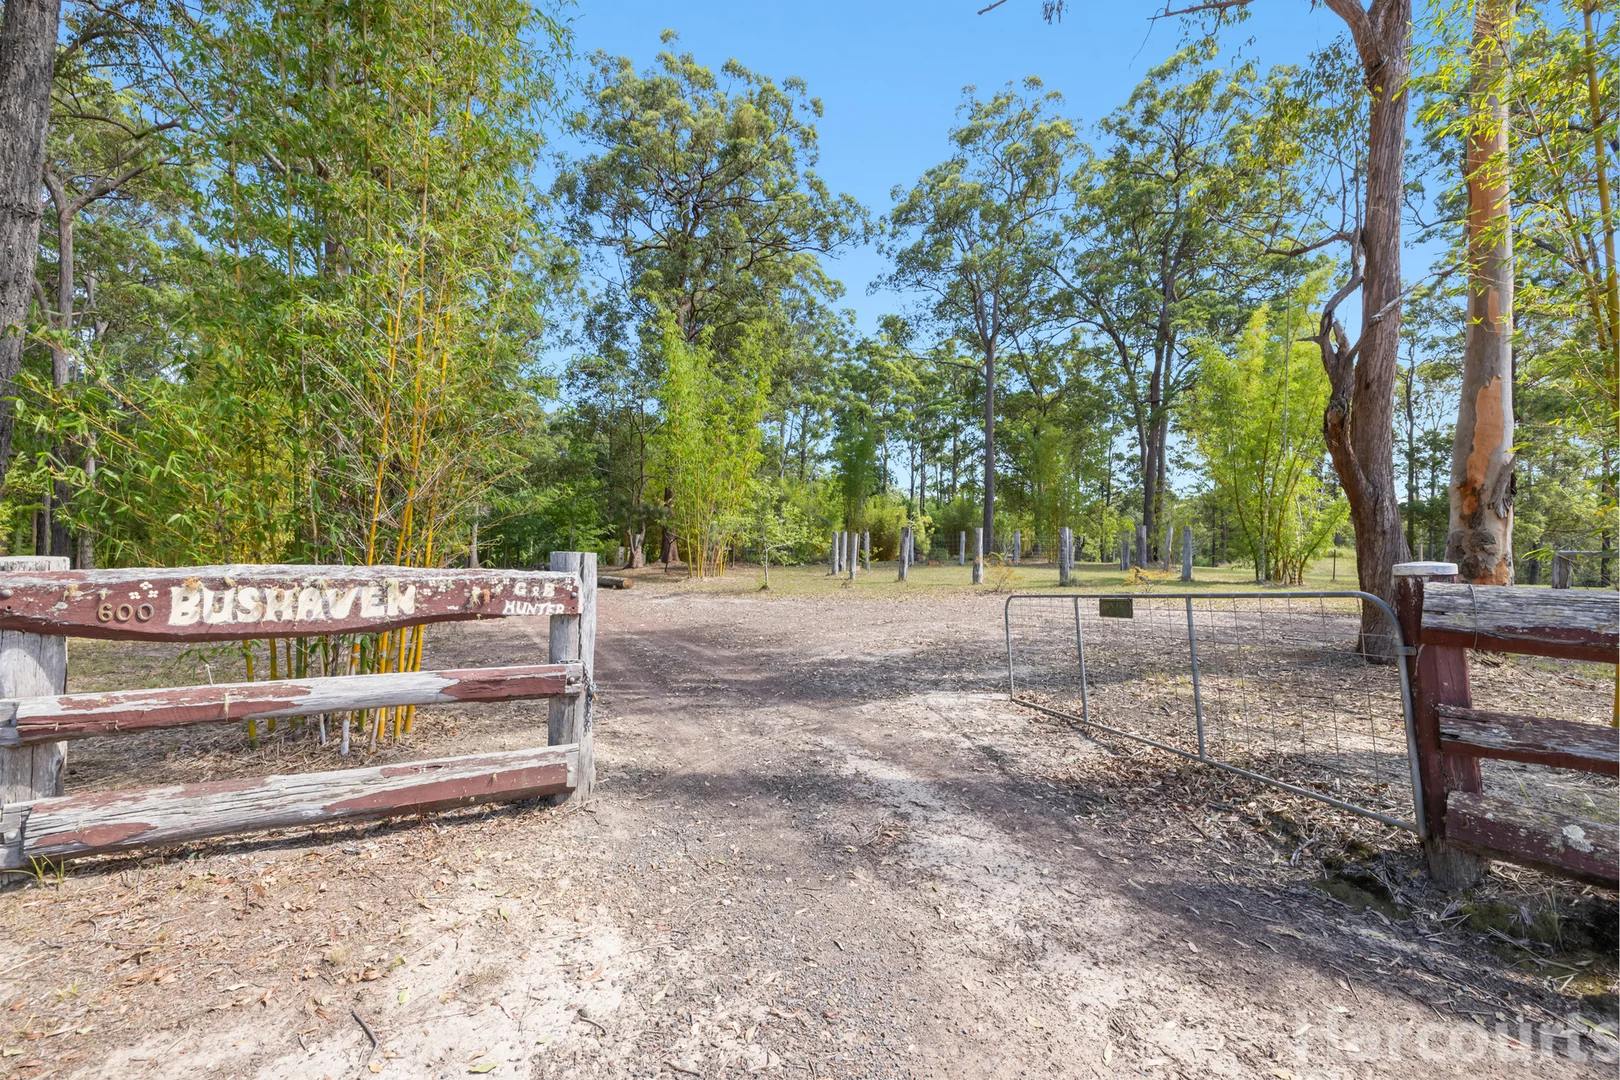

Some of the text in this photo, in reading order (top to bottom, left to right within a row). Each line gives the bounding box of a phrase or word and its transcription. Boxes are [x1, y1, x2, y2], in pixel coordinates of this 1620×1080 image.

[97, 603, 155, 623] 600
[168, 584, 416, 626] BUSHAVEN
[502, 600, 565, 615] HUNTER
